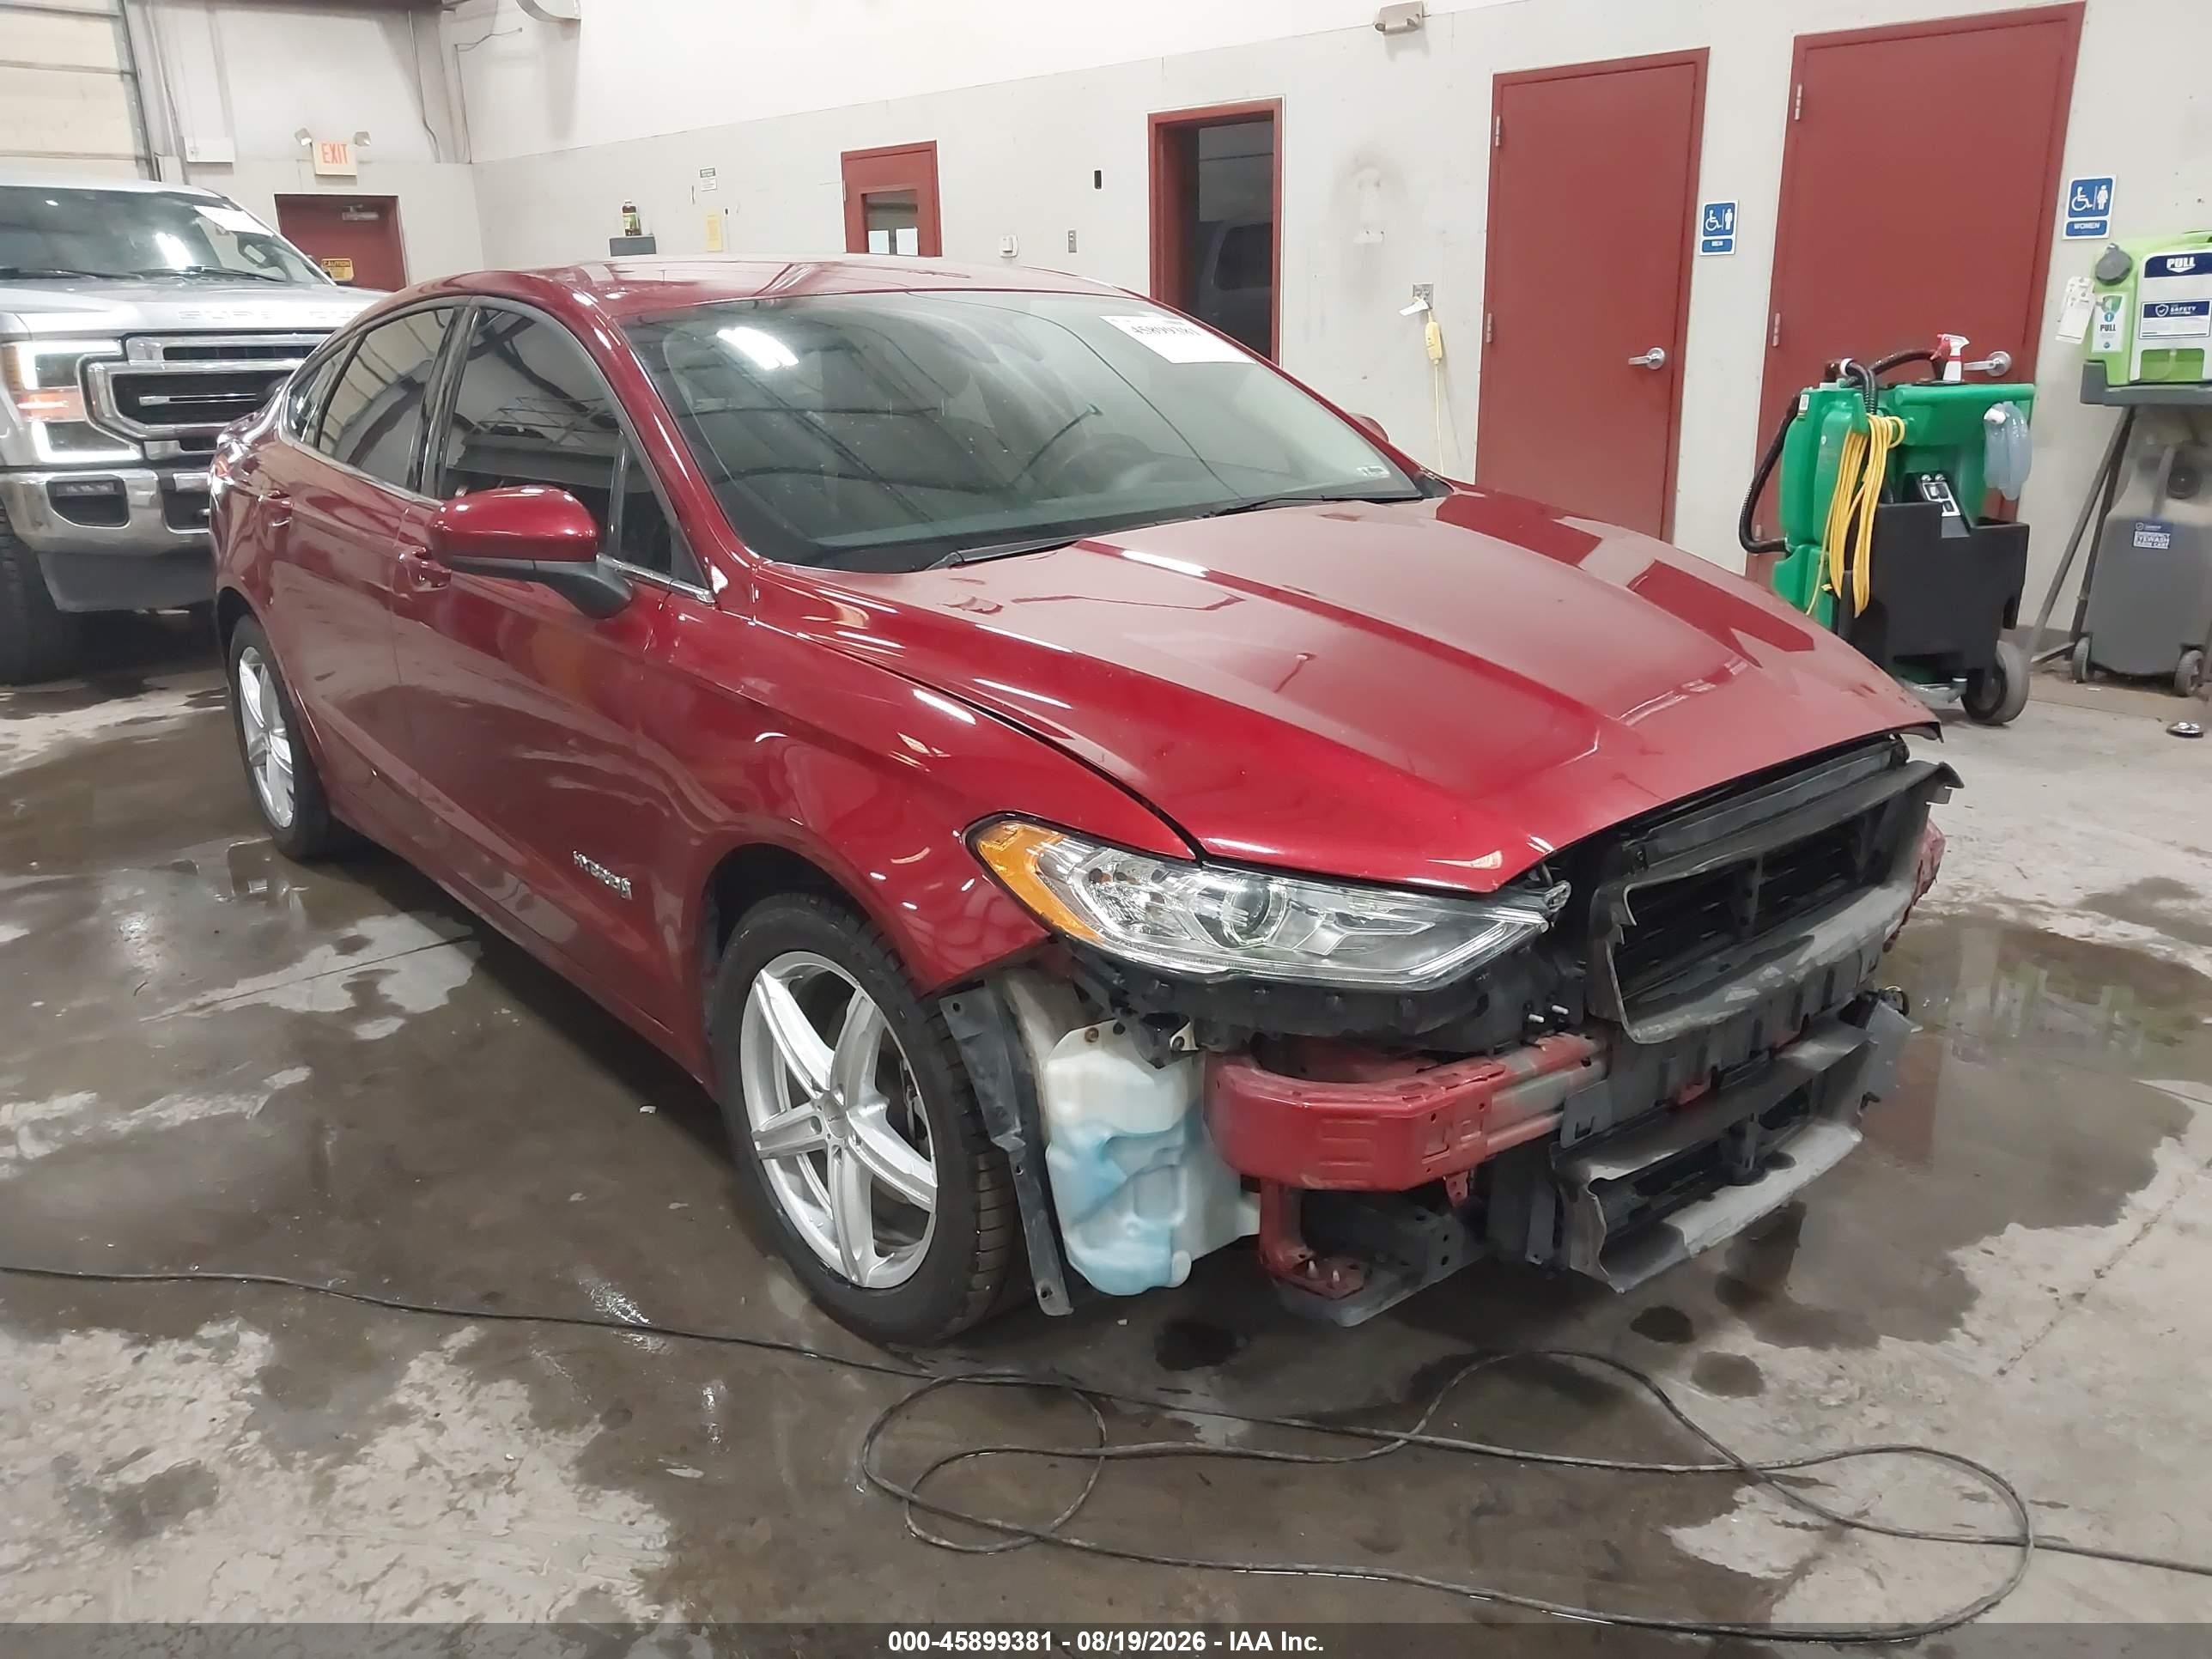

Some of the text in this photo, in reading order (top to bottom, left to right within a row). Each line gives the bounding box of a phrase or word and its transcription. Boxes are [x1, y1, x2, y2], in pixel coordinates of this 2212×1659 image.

[321, 142, 348, 165] EXIT
[2166, 257, 2196, 269] PULL
[2100, 324, 2117, 332] PULL
